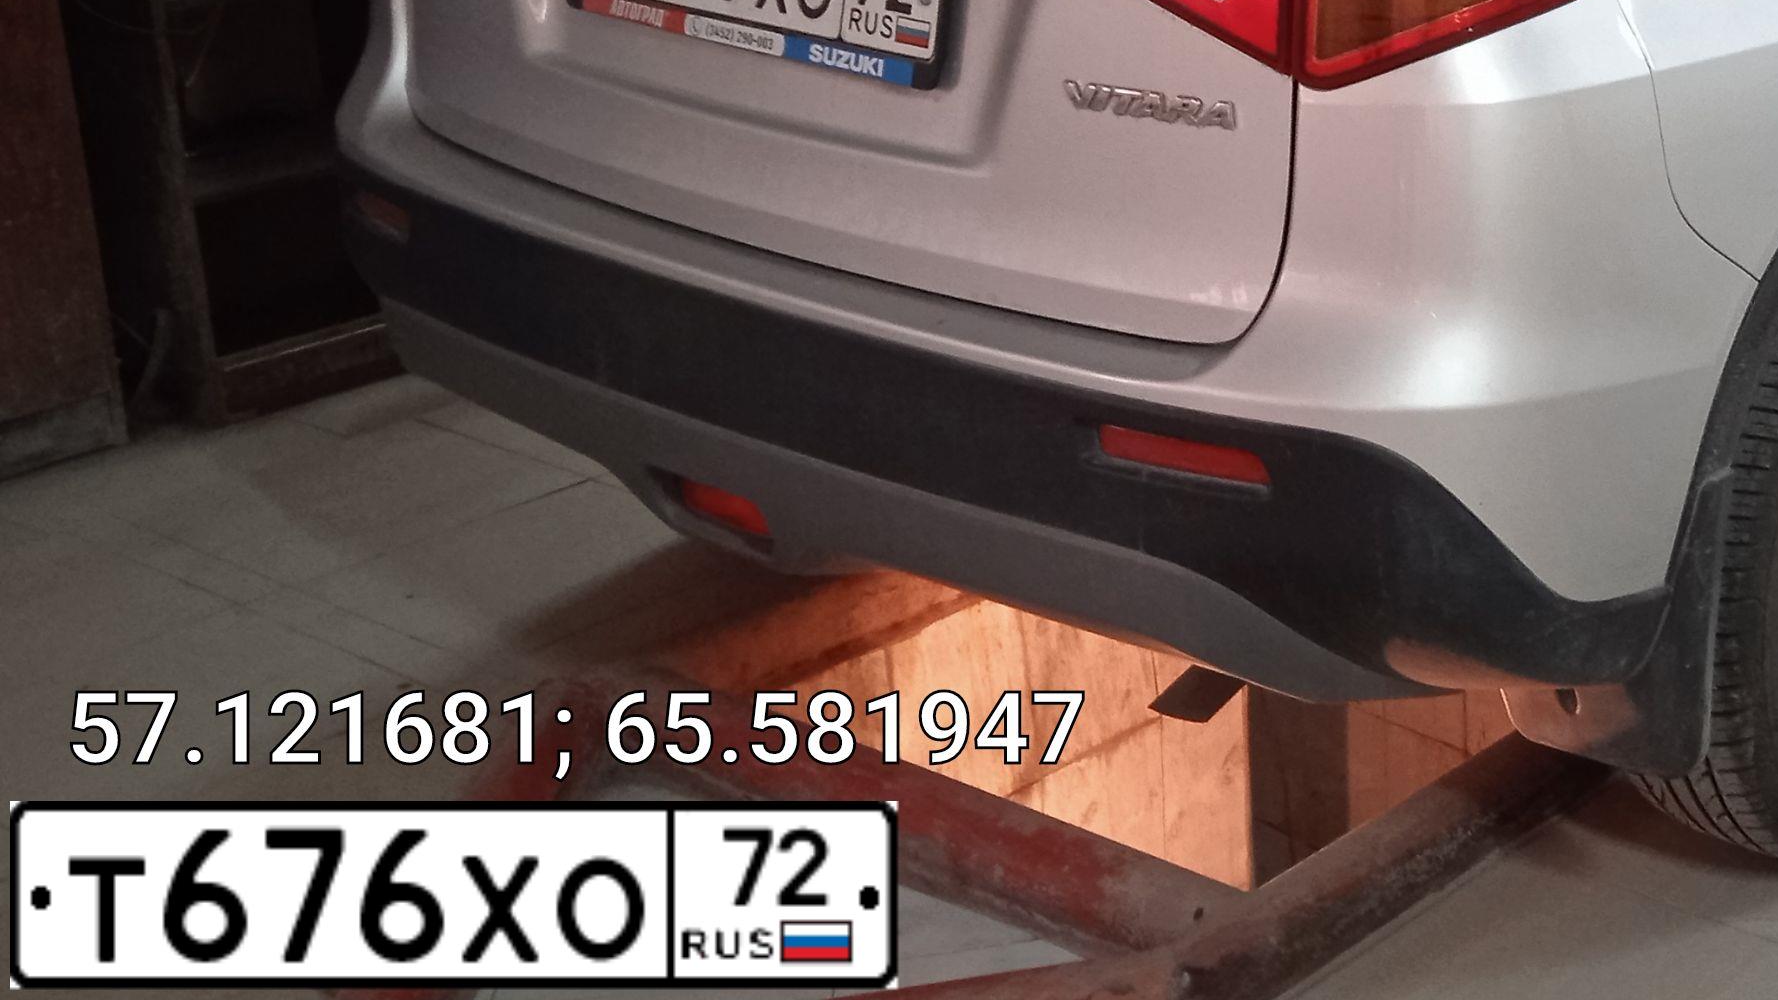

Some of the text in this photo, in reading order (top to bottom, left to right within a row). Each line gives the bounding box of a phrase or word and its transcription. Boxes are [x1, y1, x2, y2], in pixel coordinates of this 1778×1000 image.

[703, 23, 737, 45] (3452)
[848, 7, 894, 40] RUS
[808, 42, 885, 78] SUZUKI
[1063, 79, 1237, 131] VITARA
